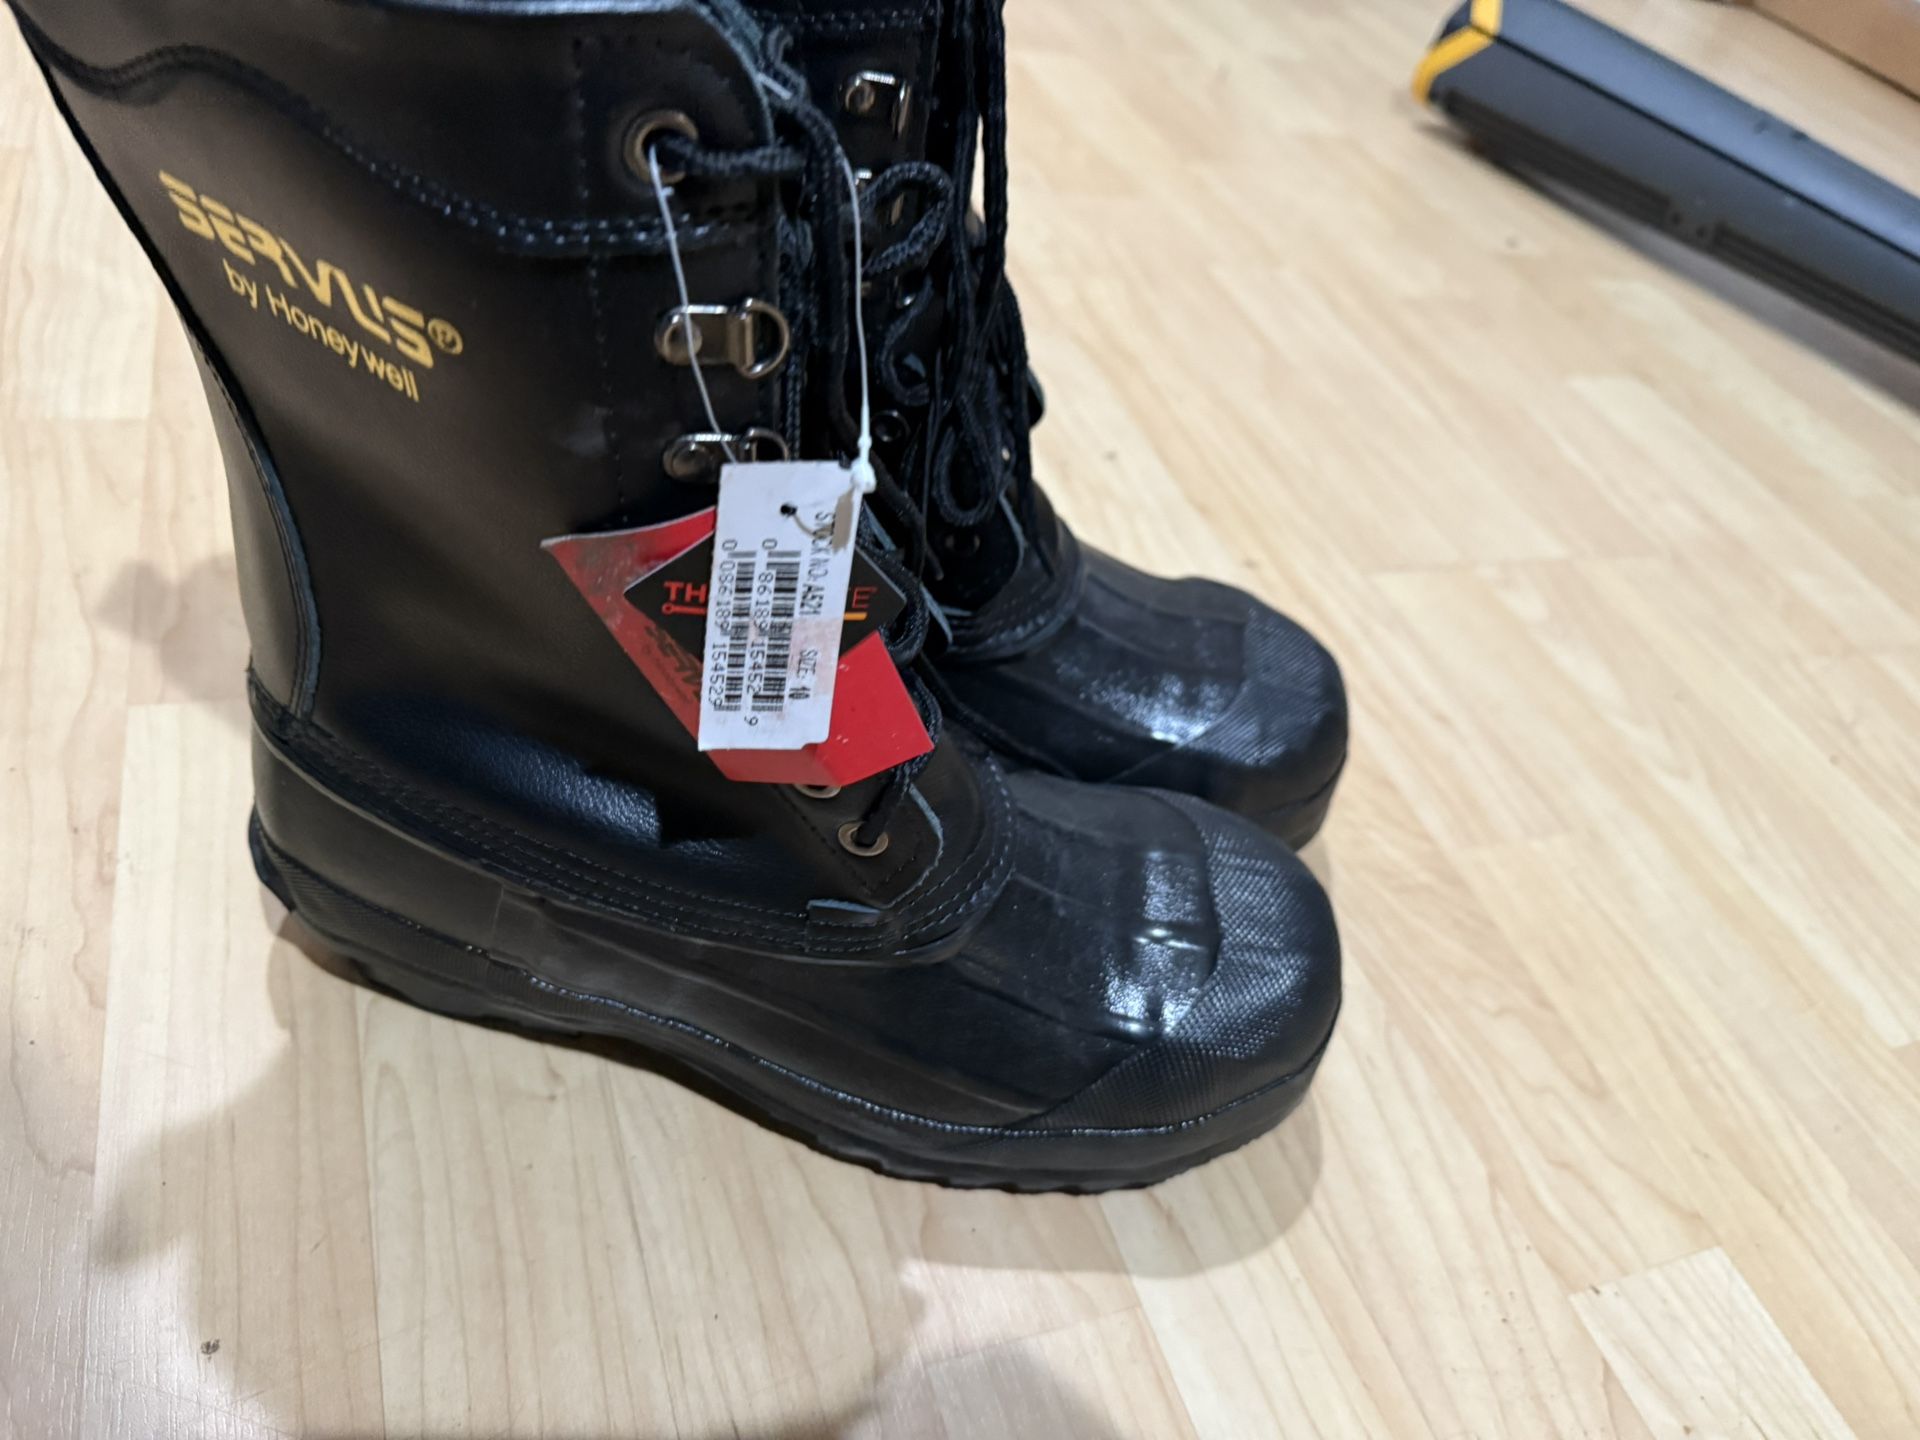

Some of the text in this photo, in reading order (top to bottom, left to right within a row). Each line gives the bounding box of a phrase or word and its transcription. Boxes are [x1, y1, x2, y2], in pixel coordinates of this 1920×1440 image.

[222, 258, 419, 402] by Honeywell
[722, 539, 737, 551] 0
[744, 539, 778, 726] 0 86189 15452 9
[799, 584, 824, 616] A521
